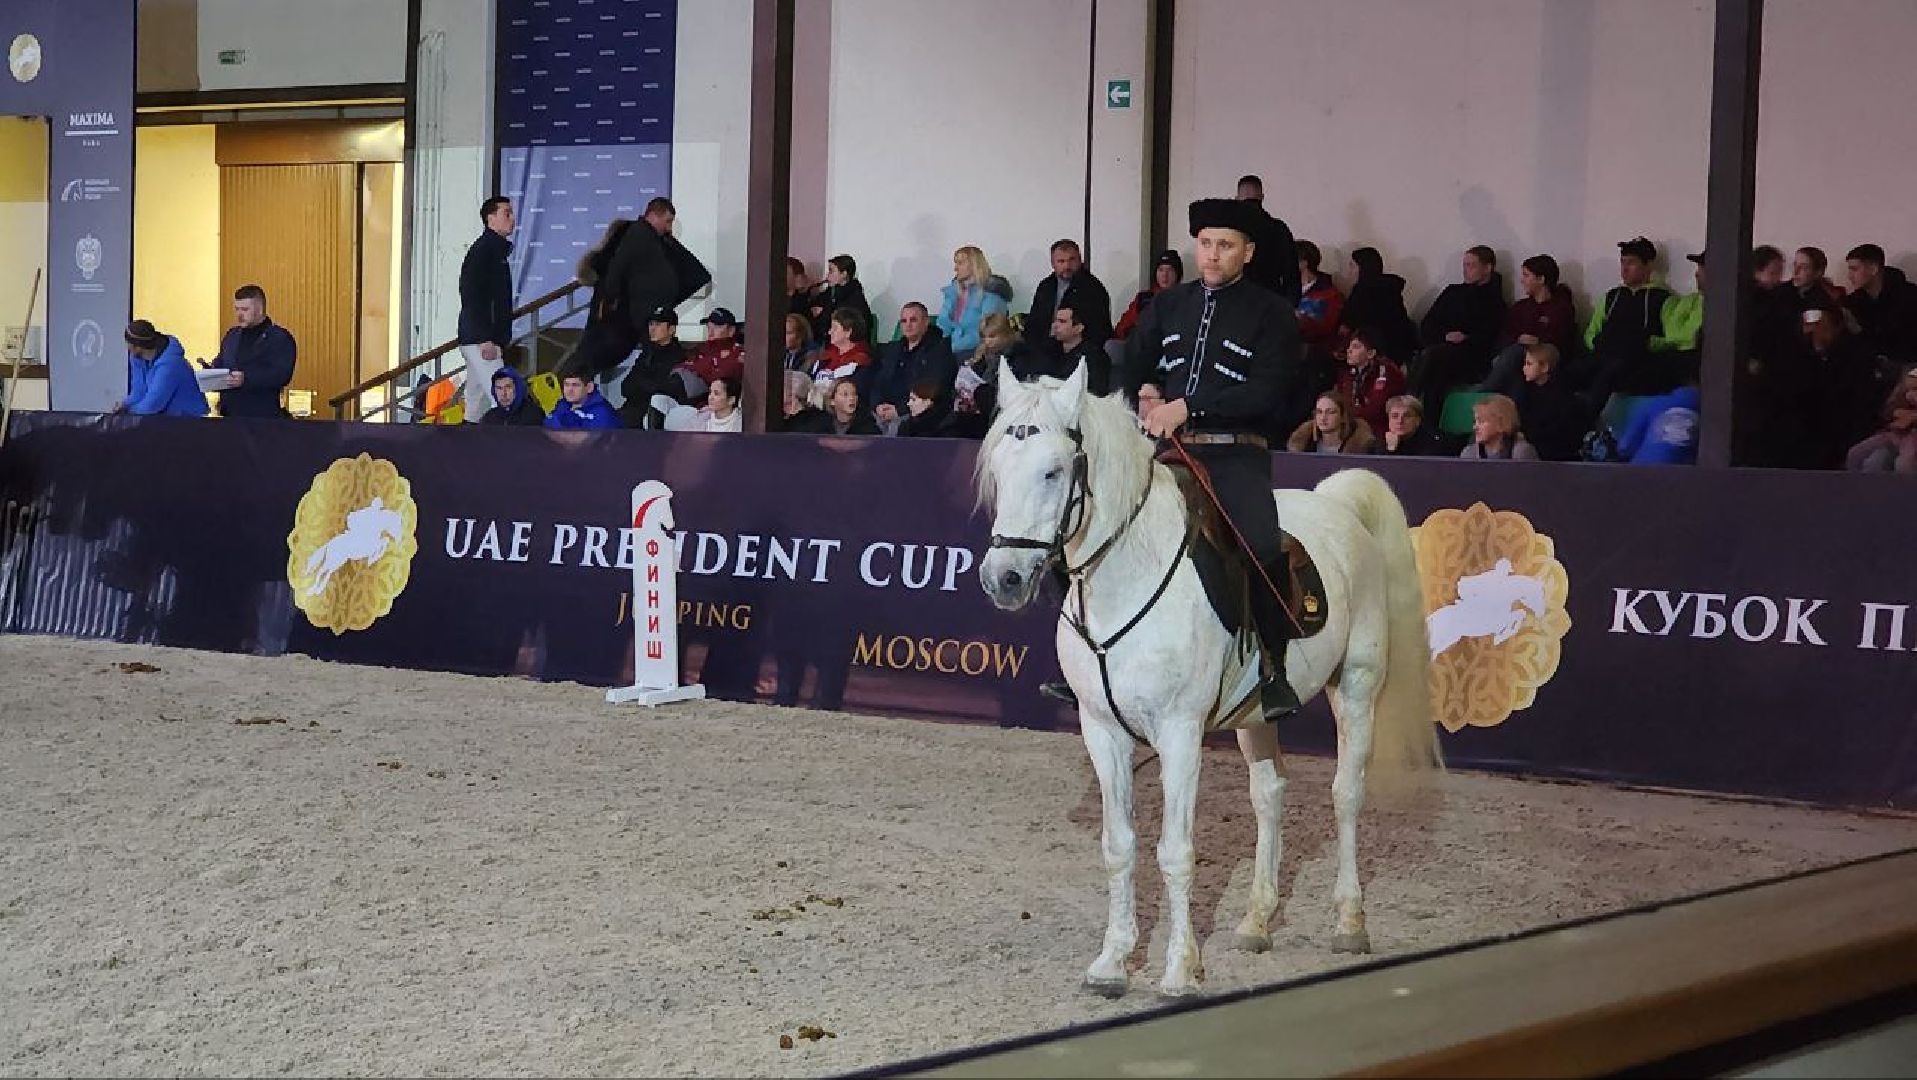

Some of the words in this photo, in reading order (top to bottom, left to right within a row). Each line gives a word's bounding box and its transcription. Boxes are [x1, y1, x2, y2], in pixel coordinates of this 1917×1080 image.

[445, 517, 533, 563] UAE
[549, 523, 842, 584] PREIDENT
[859, 542, 974, 591] CUP
[614, 592, 751, 630] JPING
[645, 539, 662, 660] ФИНИШ
[1608, 587, 1829, 646] КУБОК
[1857, 602, 1917, 652] П
[852, 631, 1030, 679] MOSCOW
